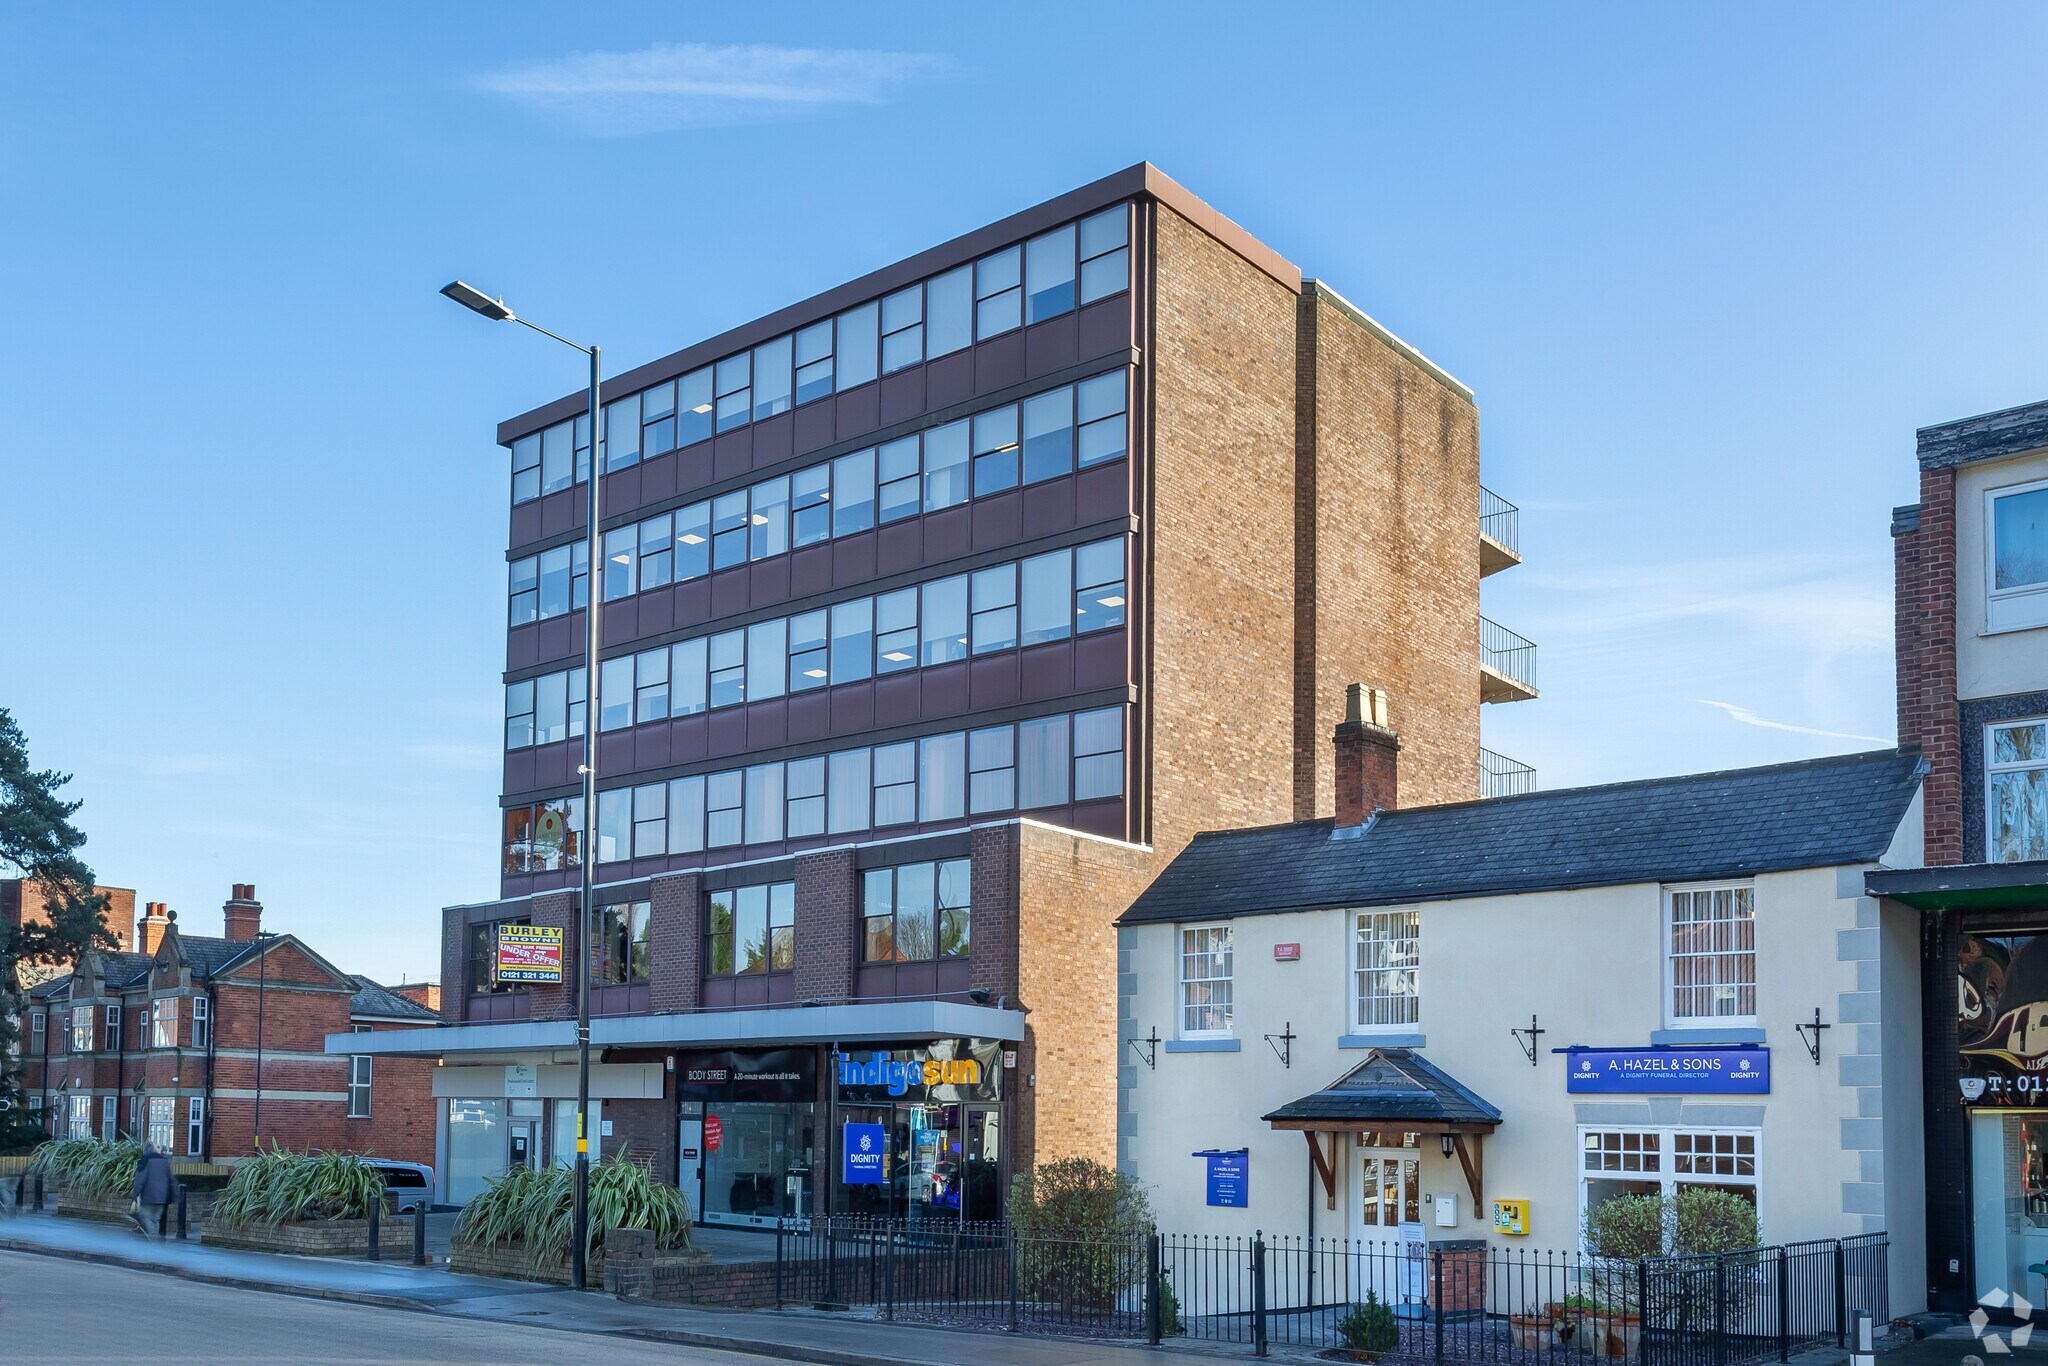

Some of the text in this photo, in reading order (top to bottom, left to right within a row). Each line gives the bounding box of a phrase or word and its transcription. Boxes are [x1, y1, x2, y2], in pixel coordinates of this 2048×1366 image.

[500, 926, 560, 936] BURLEY
[500, 943, 531, 958] UNDER
[533, 953, 561, 967] OFFER
[501, 971, 559, 980] 0121 321 3441
[1609, 1058, 1721, 1071] A. HAZEL & SONS
[688, 1070, 728, 1080] BODY STREET
[738, 1072, 758, 1080] 20-minute
[758, 1072, 775, 1080] workout
[839, 1051, 979, 1096] indigosun
[1730, 1071, 1760, 1079] DIGNITY
[1988, 1075, 2048, 1092] T:01
[850, 1154, 880, 1163] DIGNITY
